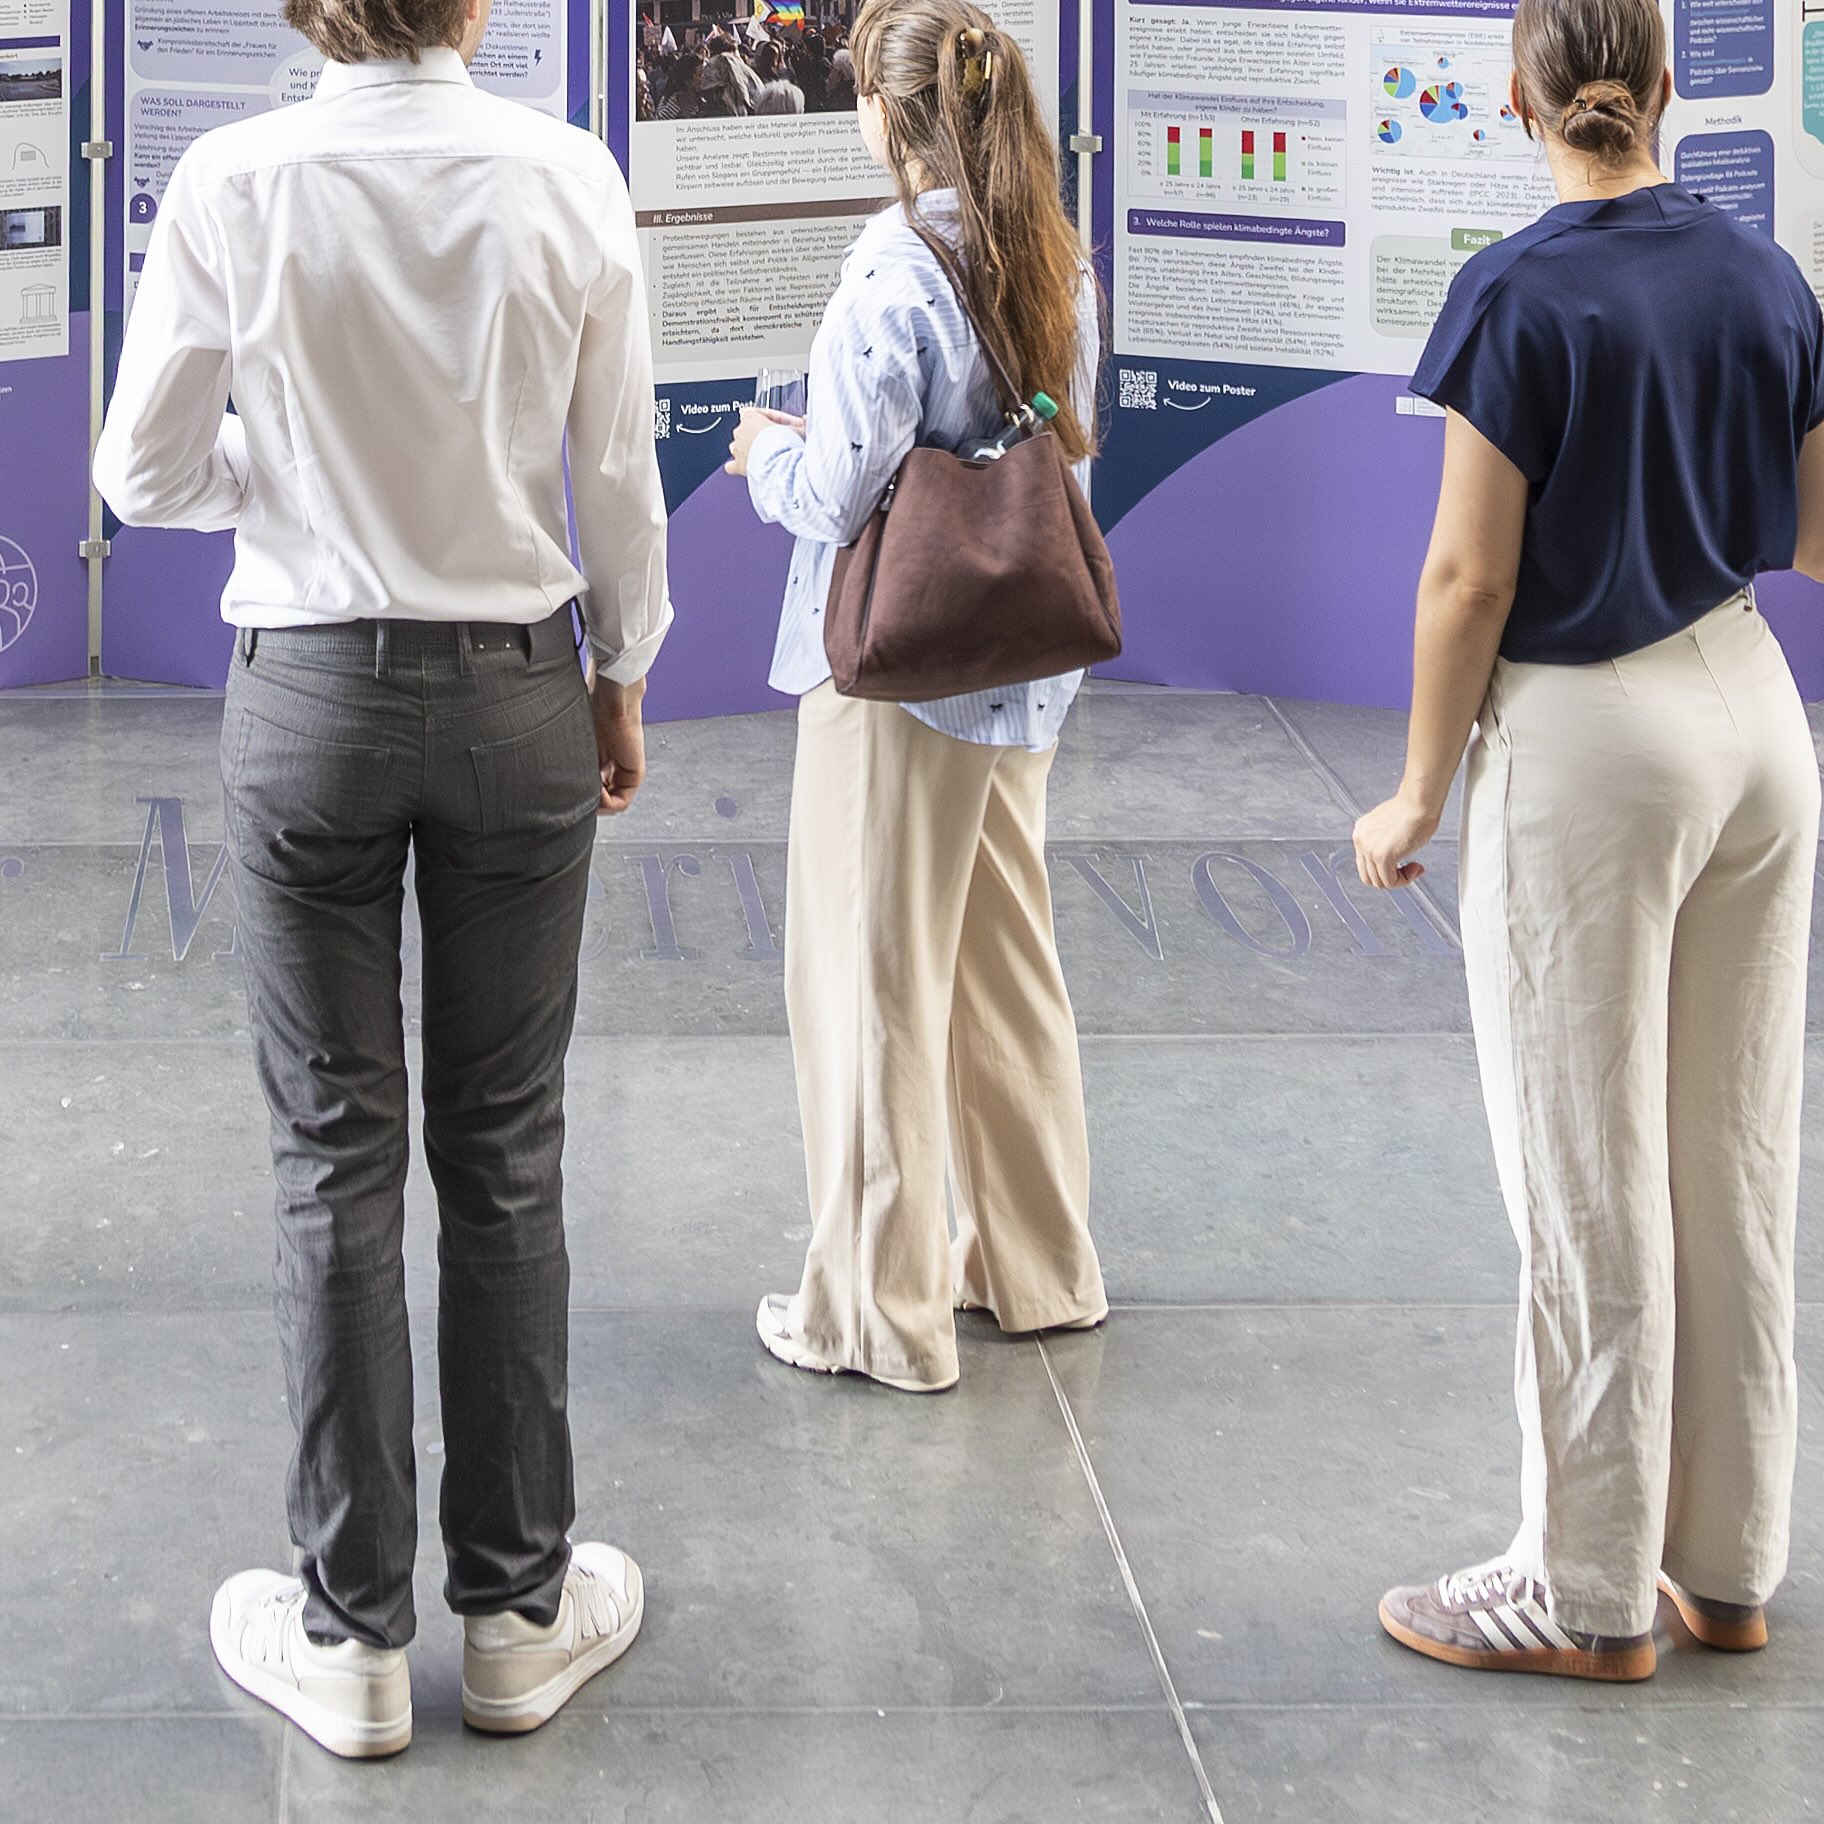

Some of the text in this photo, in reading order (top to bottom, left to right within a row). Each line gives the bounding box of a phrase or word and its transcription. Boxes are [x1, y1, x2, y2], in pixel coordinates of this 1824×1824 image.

[653, 214, 663, 224] III.
[1133, 216, 1330, 238] 3. Welche Rolle spielen klimabedingte Ängste?
[1463, 233, 1491, 245] Fazit
[1167, 379, 1256, 396] Video zum Poster
